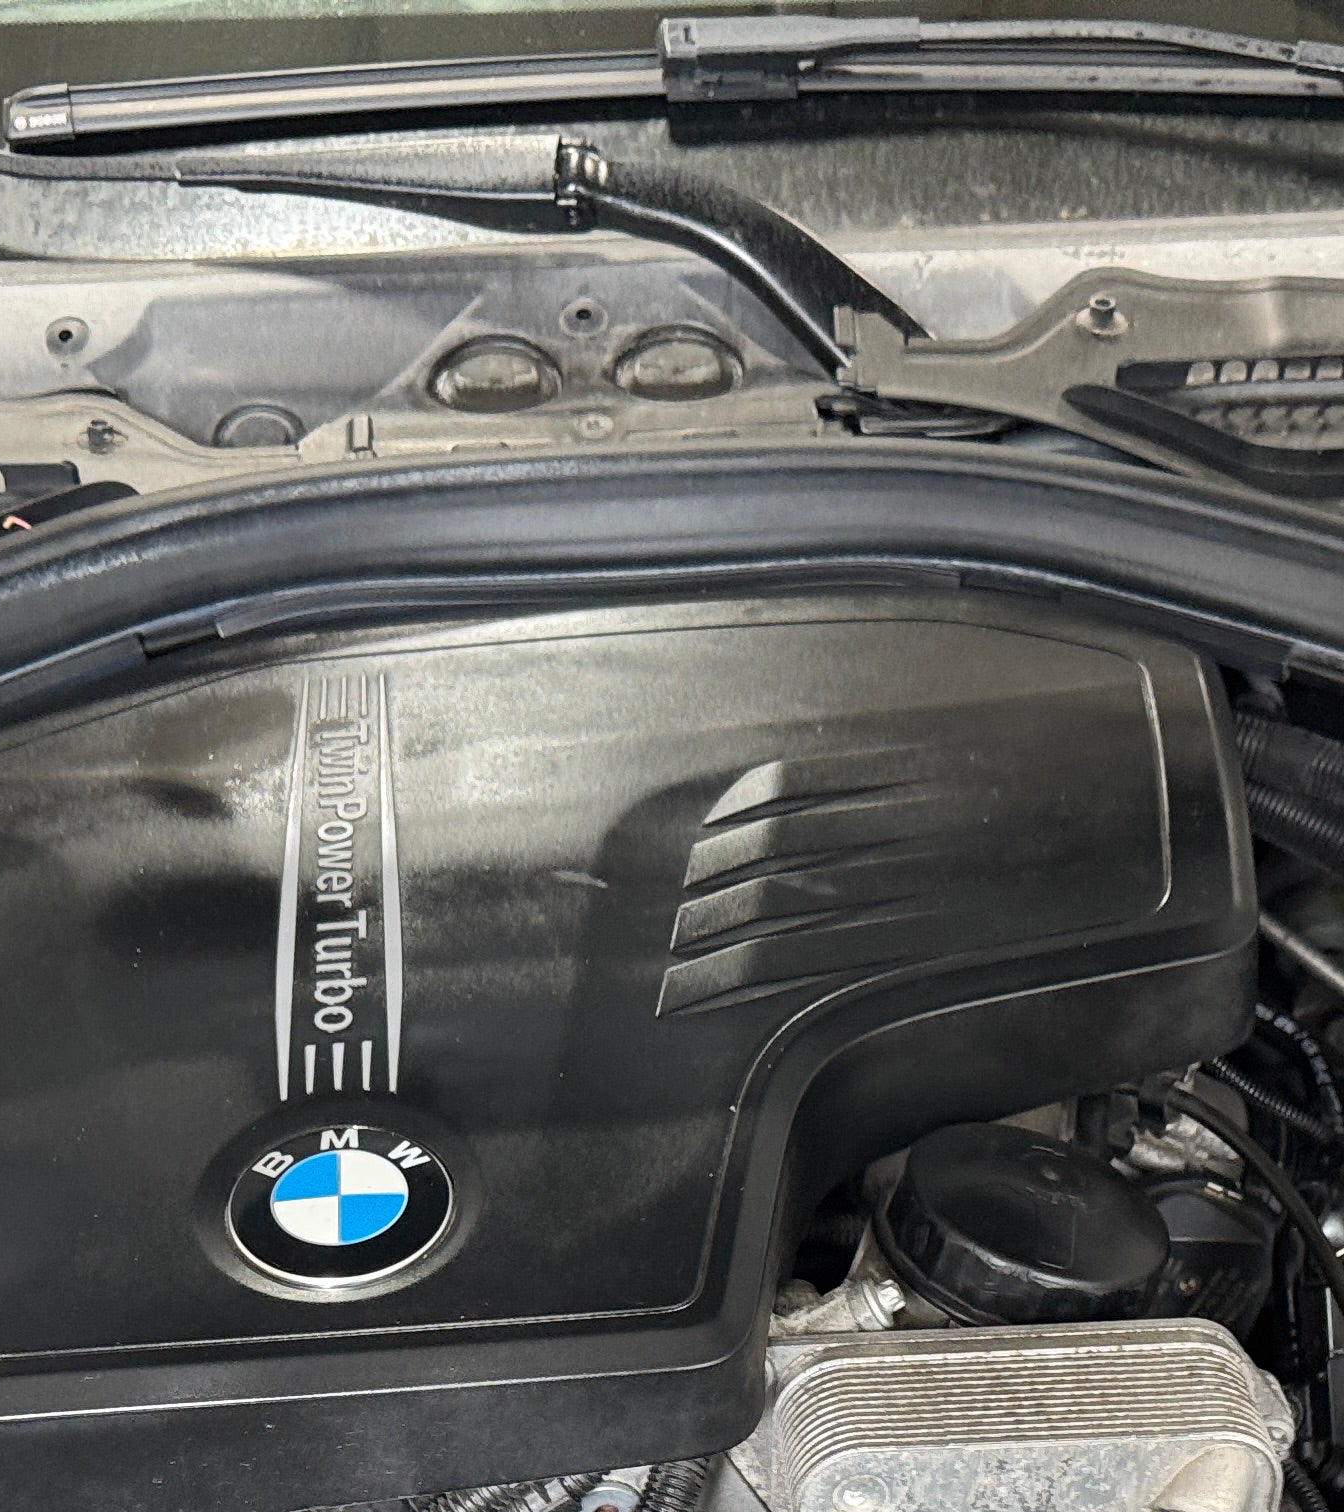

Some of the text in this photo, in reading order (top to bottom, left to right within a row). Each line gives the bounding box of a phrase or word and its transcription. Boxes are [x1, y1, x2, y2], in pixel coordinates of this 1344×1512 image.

[313, 719, 369, 1033] TwinPower Turbo
[251, 1128, 432, 1179] BMW
